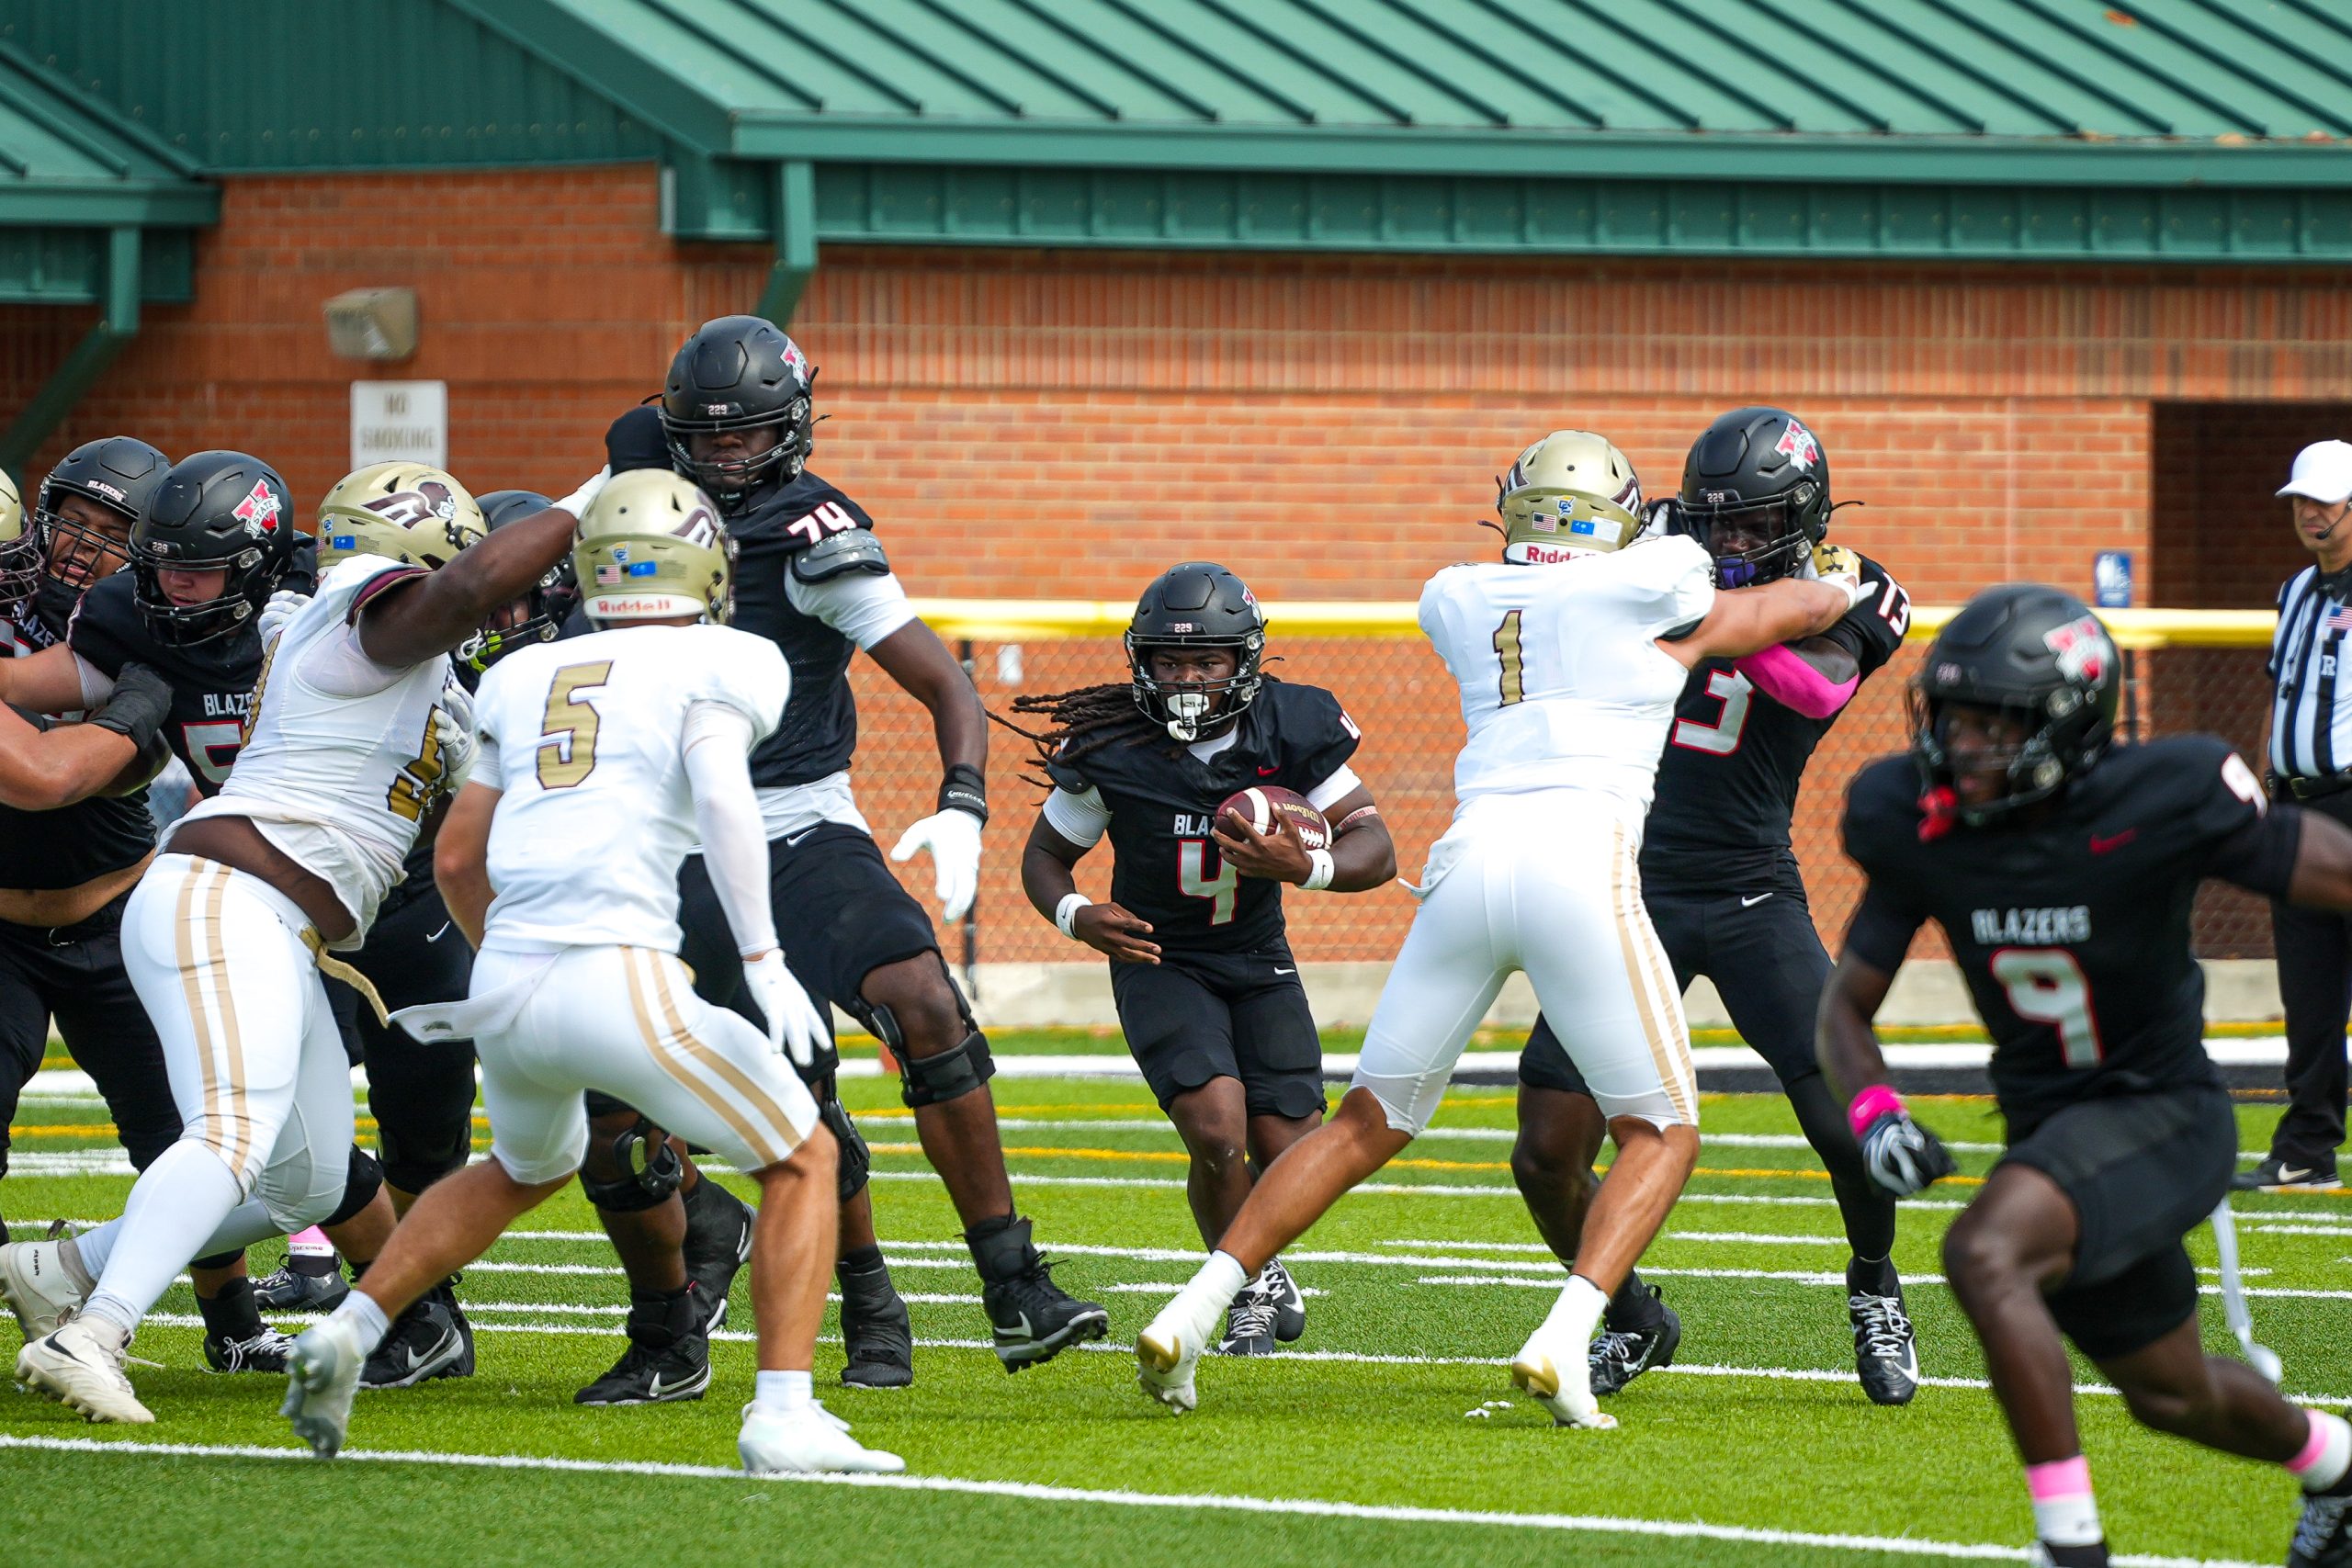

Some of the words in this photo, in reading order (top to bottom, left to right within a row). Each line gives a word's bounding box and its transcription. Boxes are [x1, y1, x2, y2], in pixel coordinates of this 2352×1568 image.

[708, 404, 728, 415] 229
[87, 480, 124, 501] BLAZERS
[1707, 493, 1724, 502] 229
[254, 500, 274, 525] STATE
[787, 501, 857, 545] 74
[153, 542, 168, 553] 229
[1526, 546, 1580, 563] Ridd
[597, 599, 670, 613] Riddell
[1877, 571, 1910, 637] 13
[1174, 623, 1193, 633] 229
[1492, 610, 1525, 709] 1
[2321, 655, 2336, 676] R
[536, 660, 615, 790] 5
[1282, 802, 1320, 825] Wilson
[1177, 839, 1239, 926] 4
[1971, 905, 2091, 944] BLAZERS
[1988, 945, 2107, 1068] 9
